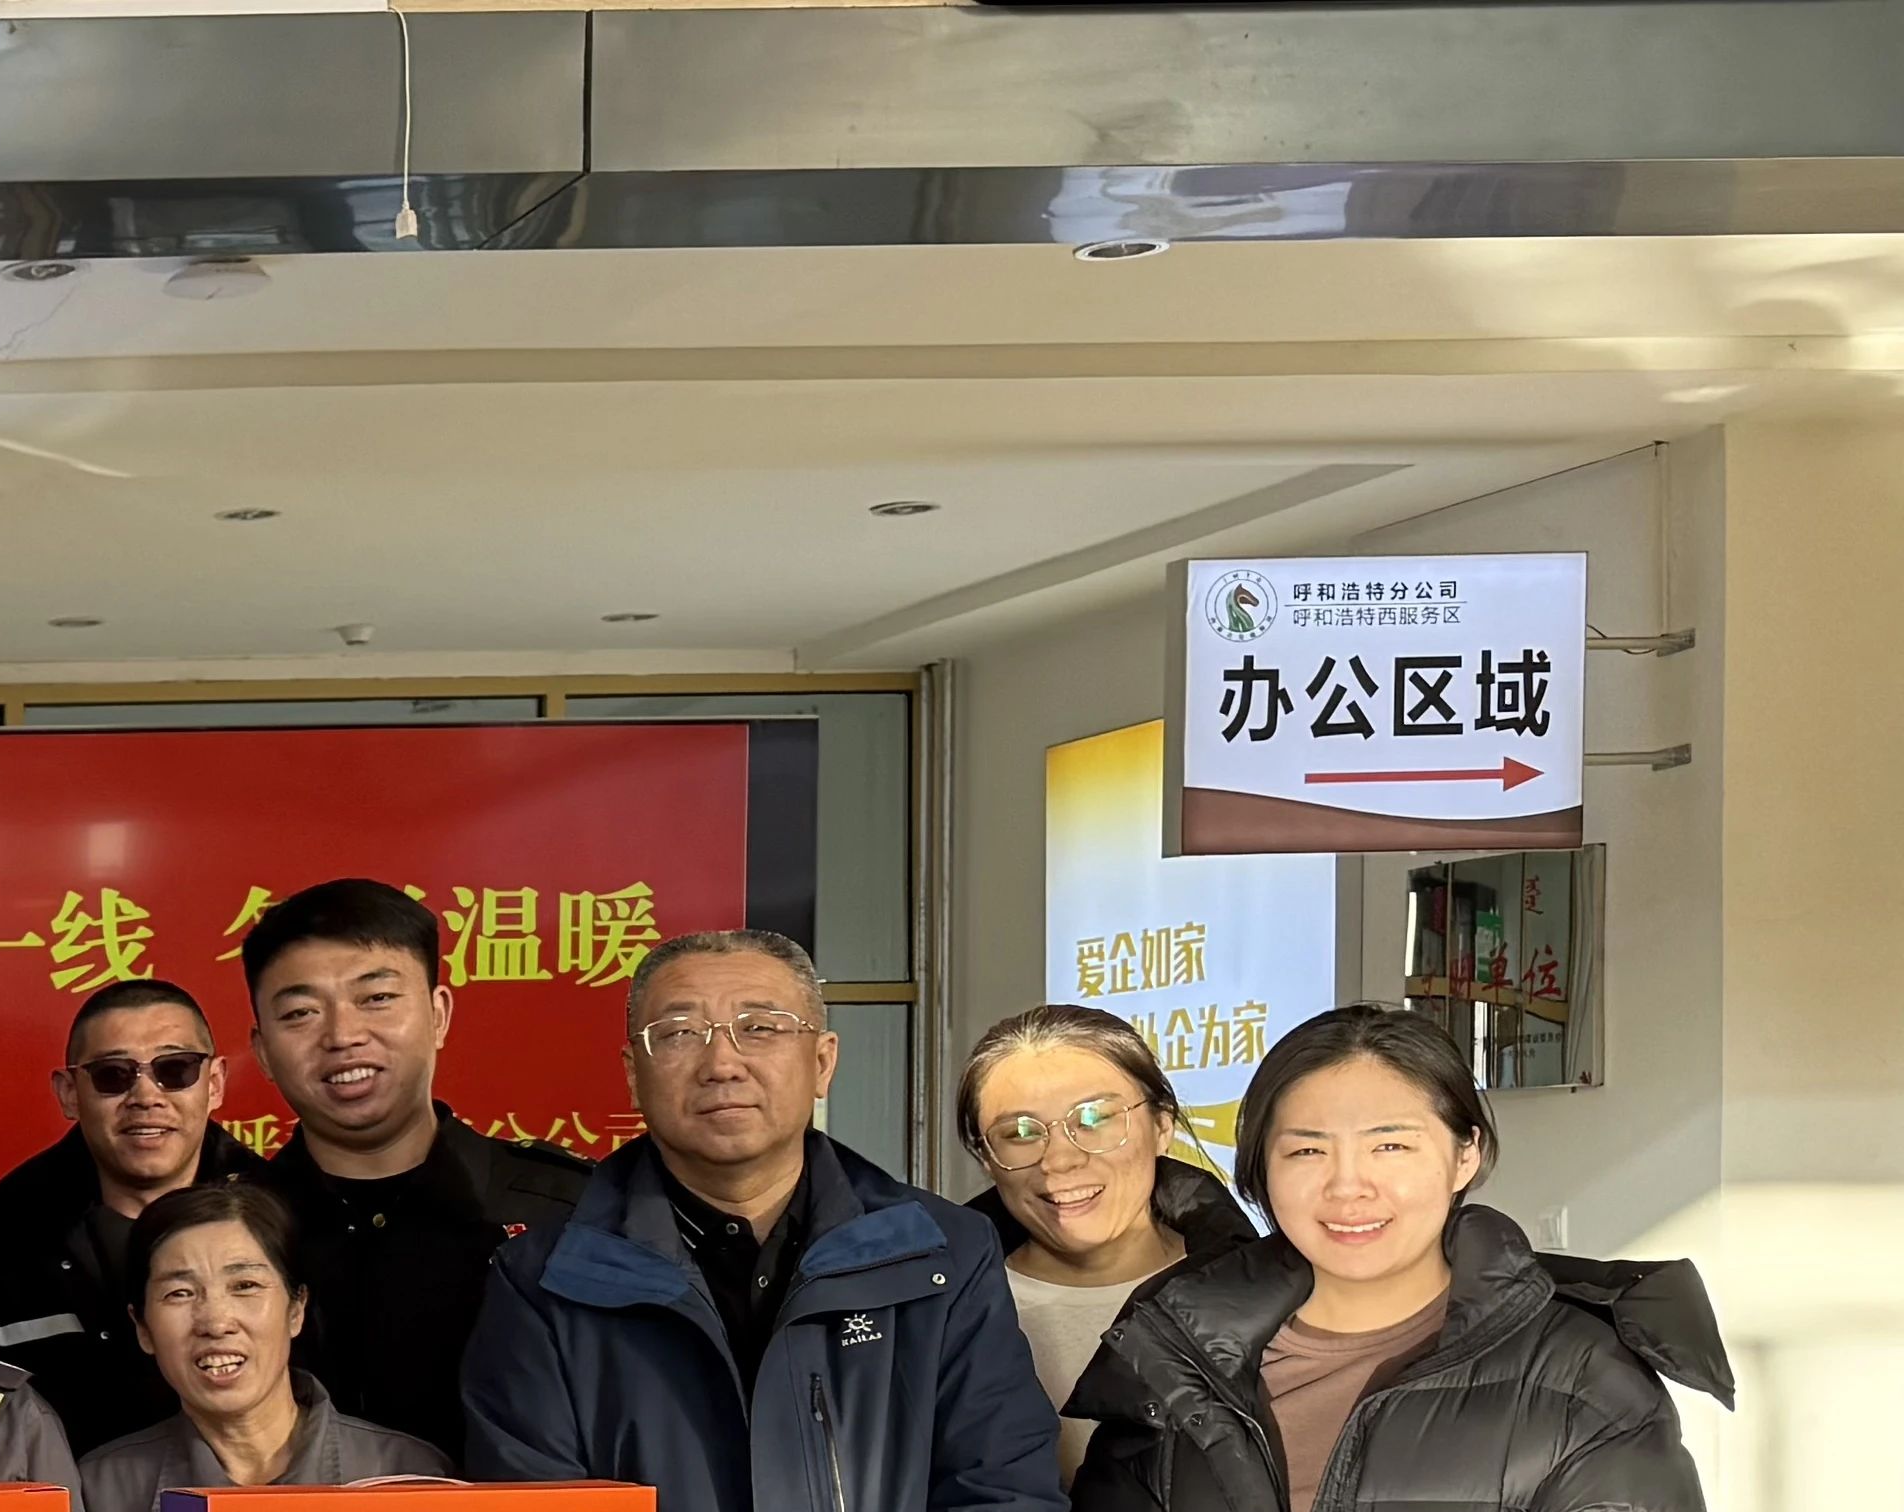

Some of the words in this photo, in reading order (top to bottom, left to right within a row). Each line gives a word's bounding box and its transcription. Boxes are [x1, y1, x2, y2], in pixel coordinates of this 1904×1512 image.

[1293, 581, 1458, 602] 呼和浩特分公司
[1293, 606, 1461, 627] 呼和浩特西服务区
[1217, 649, 1552, 742] 办公区域
[1076, 921, 1206, 998] 爱企如家
